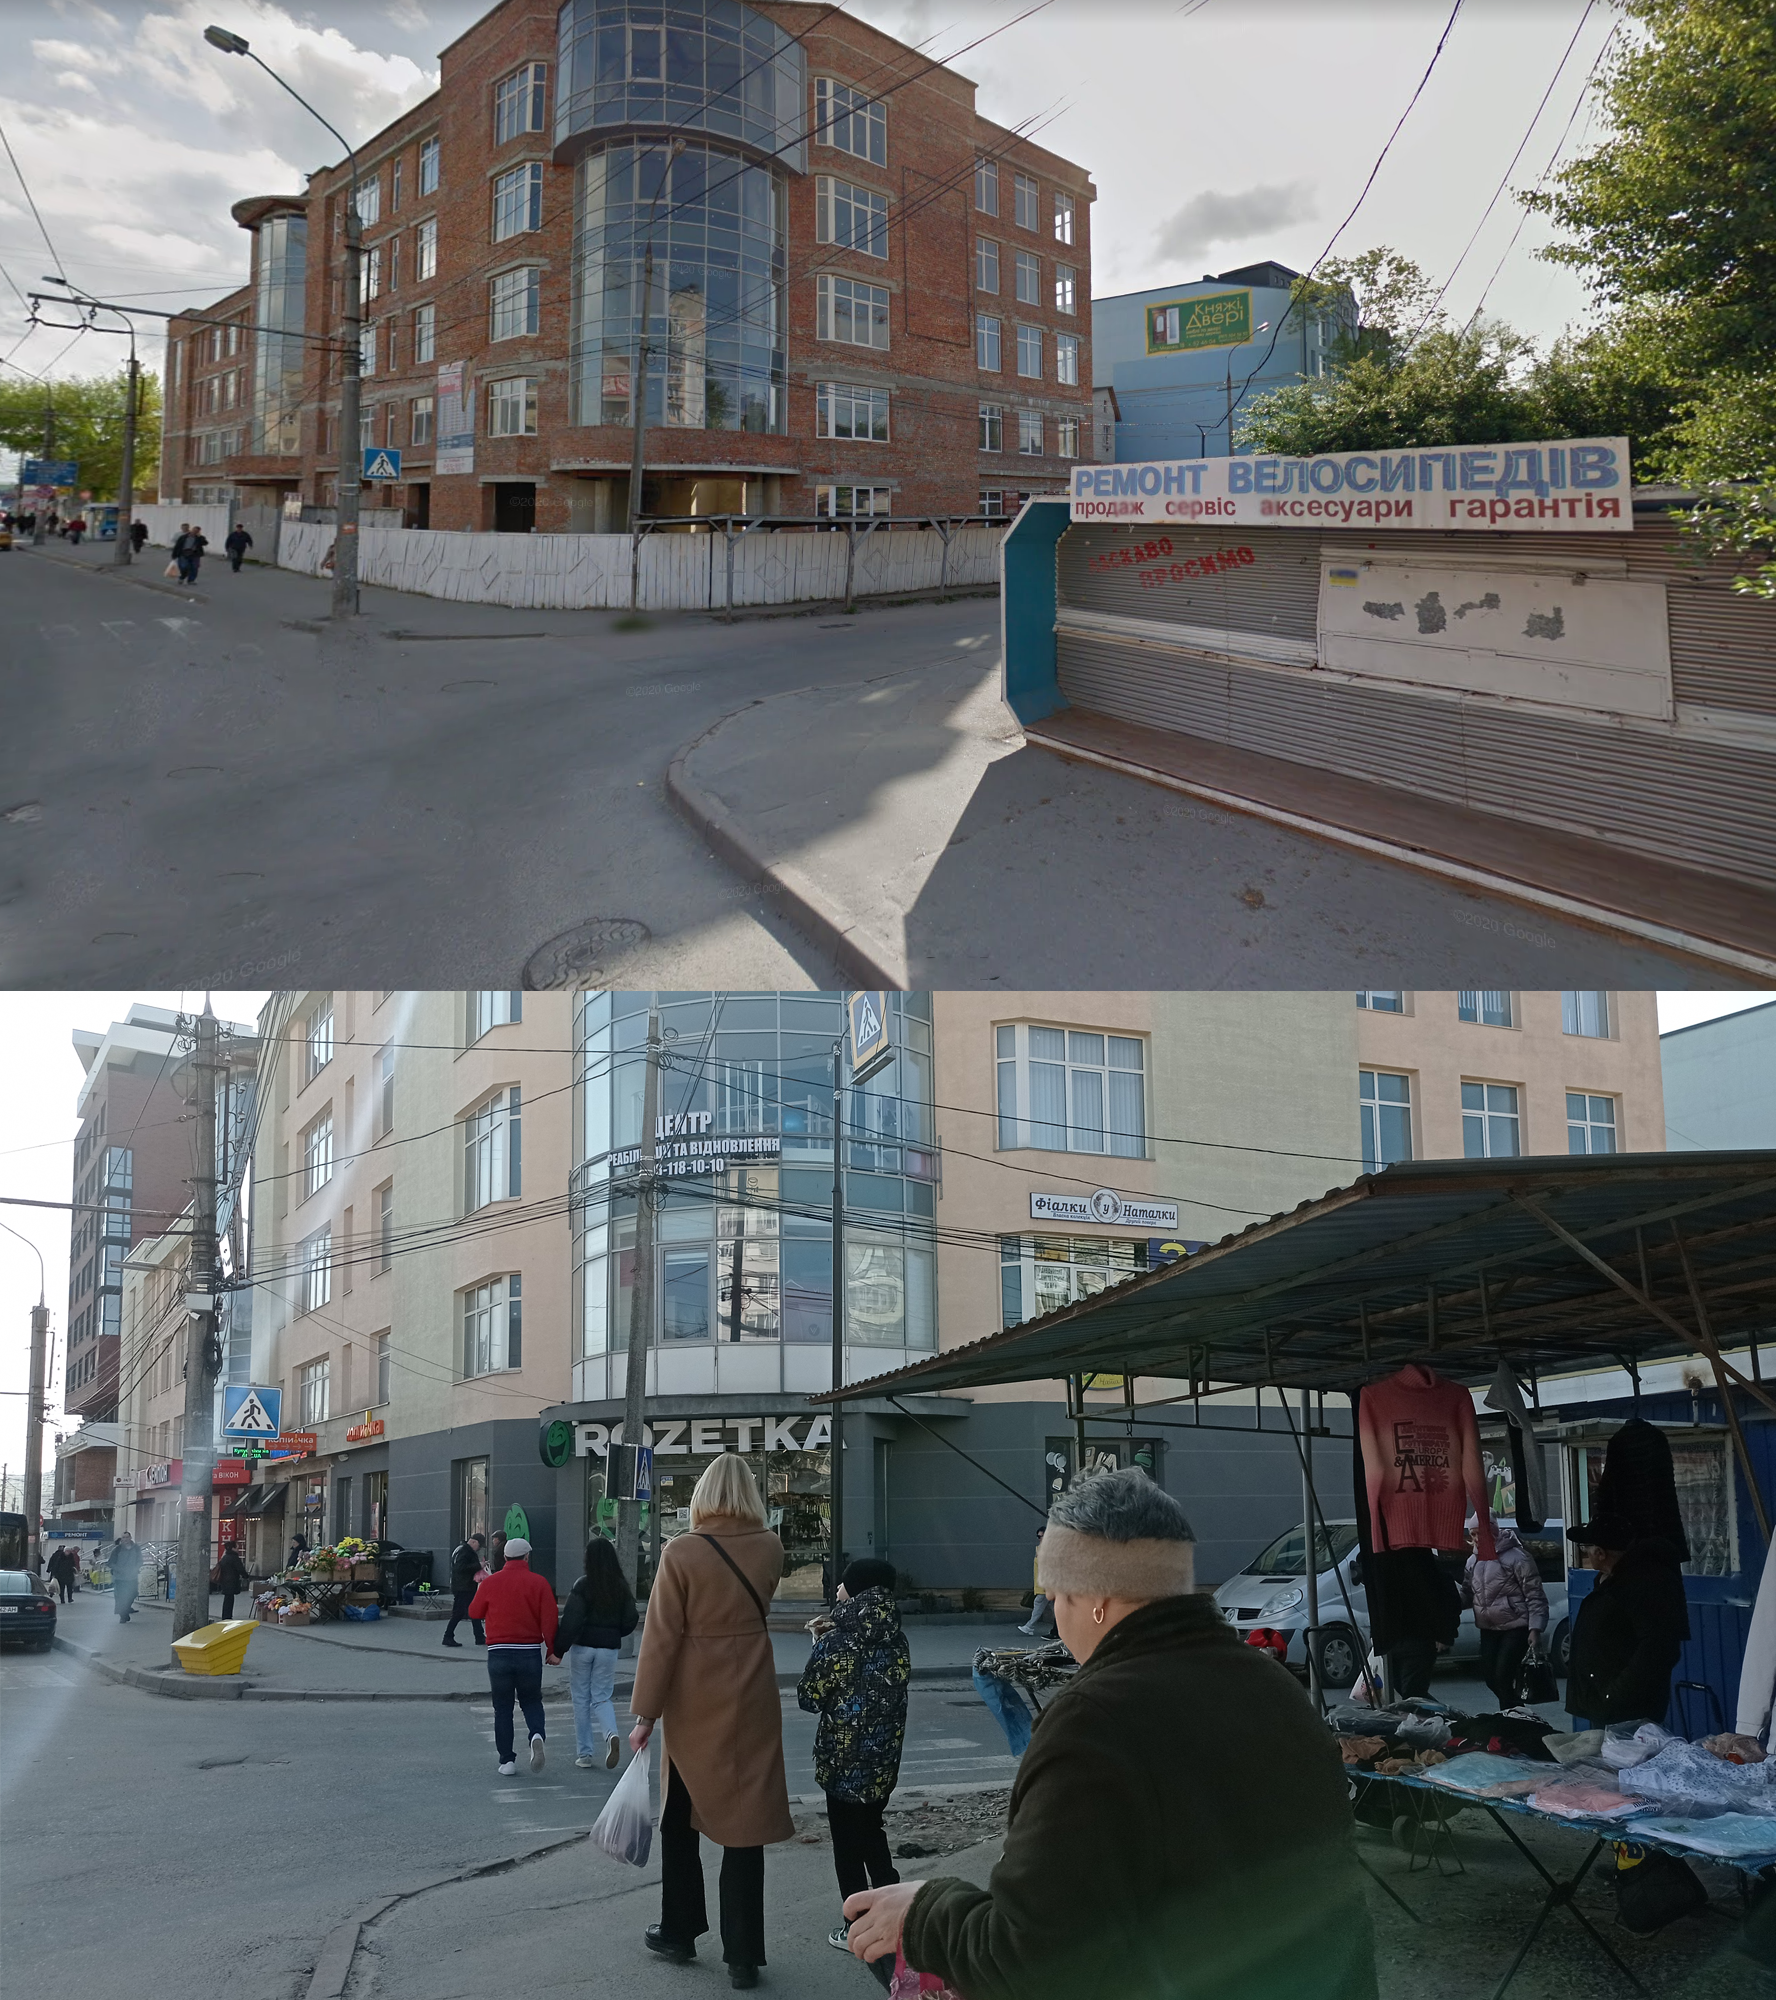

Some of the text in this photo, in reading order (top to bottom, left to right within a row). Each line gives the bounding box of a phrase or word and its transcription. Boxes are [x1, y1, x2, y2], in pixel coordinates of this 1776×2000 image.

[1186, 305, 1243, 330] Двері
[1195, 297, 1240, 315] Княжі
[1075, 446, 1620, 498] РЕМОНТ ВЕЛОСИПЕДІВ
[1075, 492, 1621, 524] продаж сервіс аксесуари гарантія
[1138, 546, 1255, 590] ПРОСИМО
[655, 1111, 712, 1141] ЦЕНТР
[673, 1142, 688, 1157] ТА
[690, 1138, 780, 1156] ВІДНОВЛЕННЯ
[1035, 1197, 1176, 1220] Фіалки у Наталки
